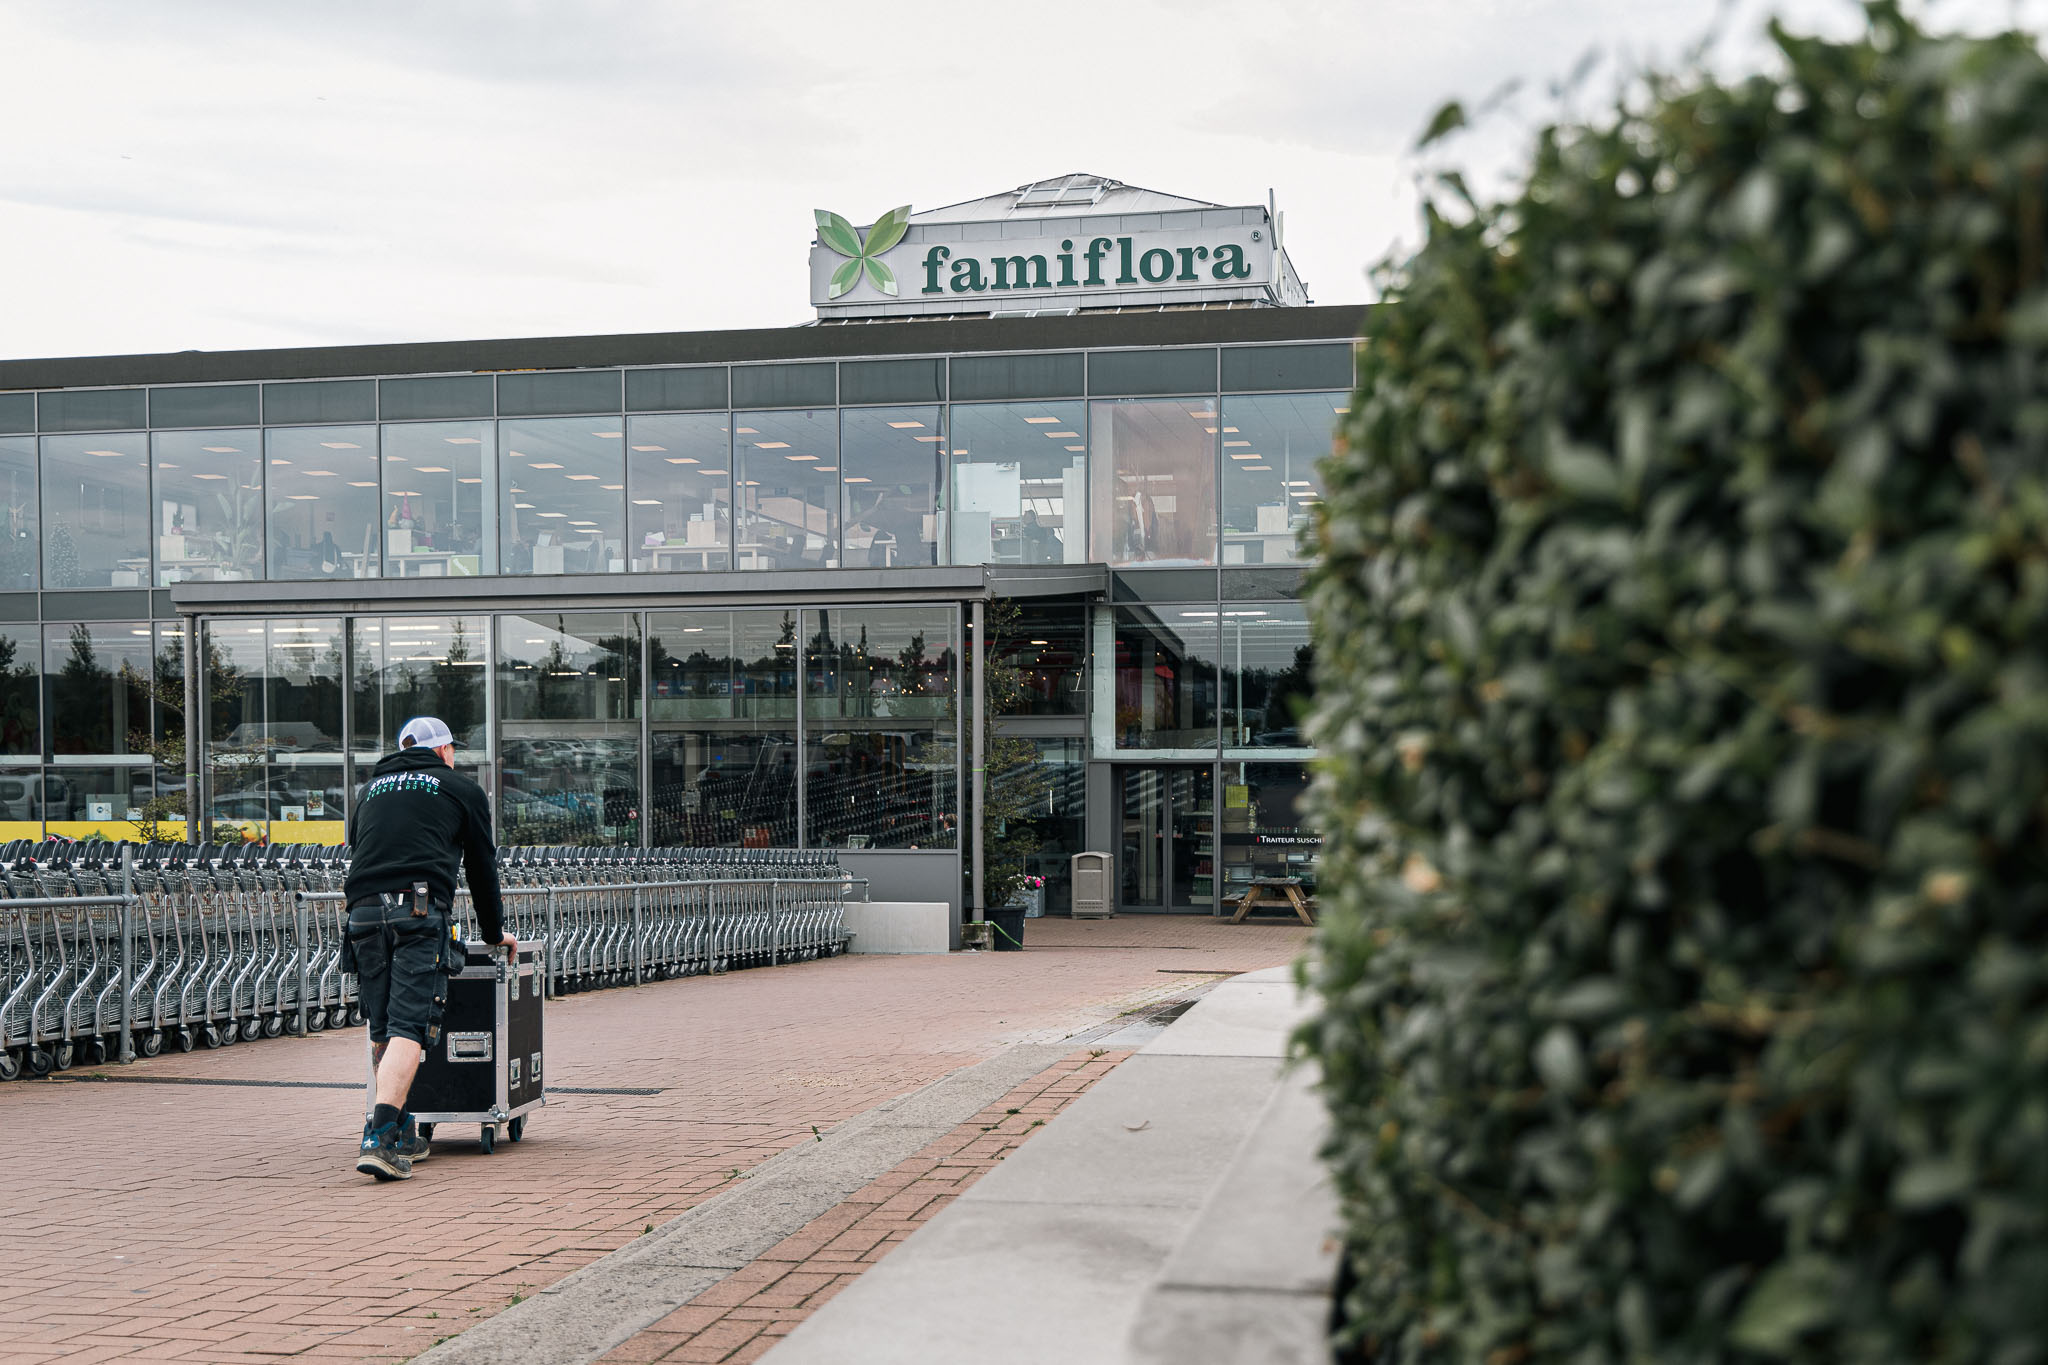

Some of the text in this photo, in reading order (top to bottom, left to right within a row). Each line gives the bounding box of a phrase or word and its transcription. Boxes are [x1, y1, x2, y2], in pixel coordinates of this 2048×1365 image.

[921, 237, 1252, 295] famiflora
[408, 773, 441, 787] LIVE
[1260, 835, 1295, 844] TRAITEUR
